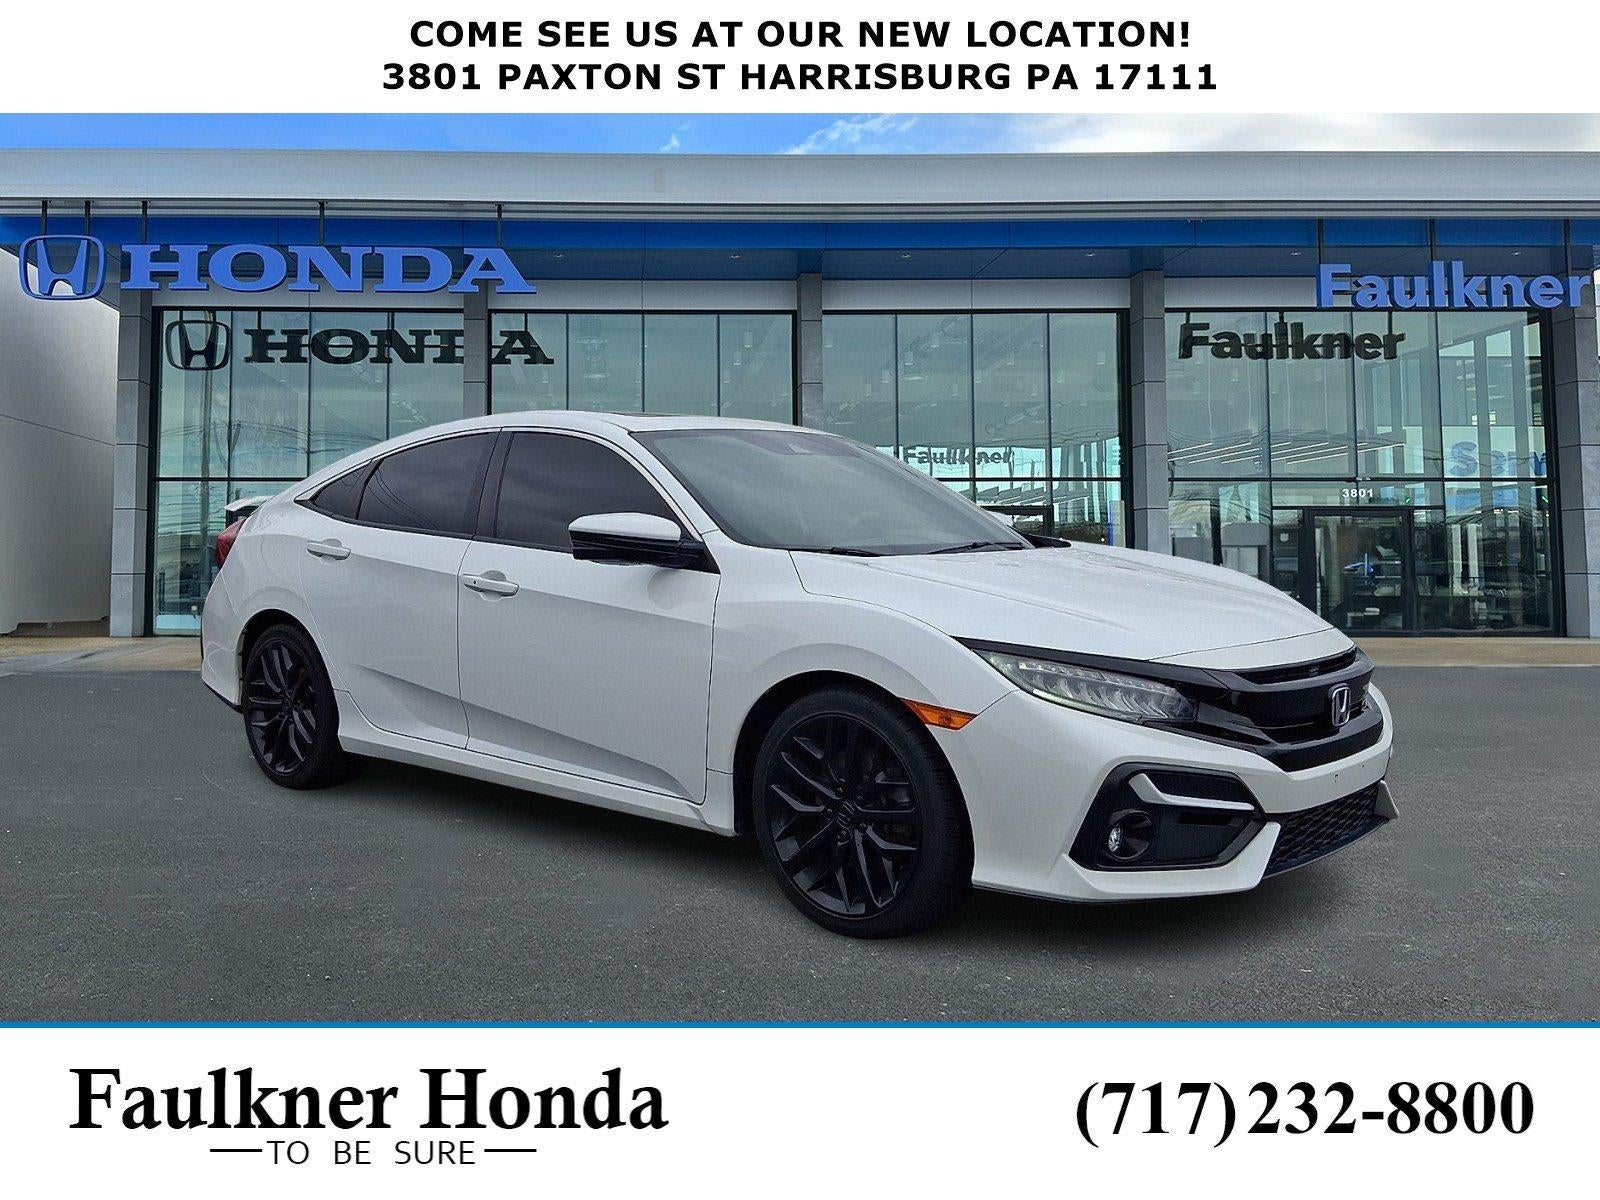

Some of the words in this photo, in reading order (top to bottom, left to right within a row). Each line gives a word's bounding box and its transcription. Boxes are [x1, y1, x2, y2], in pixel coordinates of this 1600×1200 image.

[120, 244, 537, 295] HONDA
[1316, 260, 1591, 310] Faulkner
[1178, 321, 1407, 360] Faulkner
[1341, 488, 1374, 498] 3801
